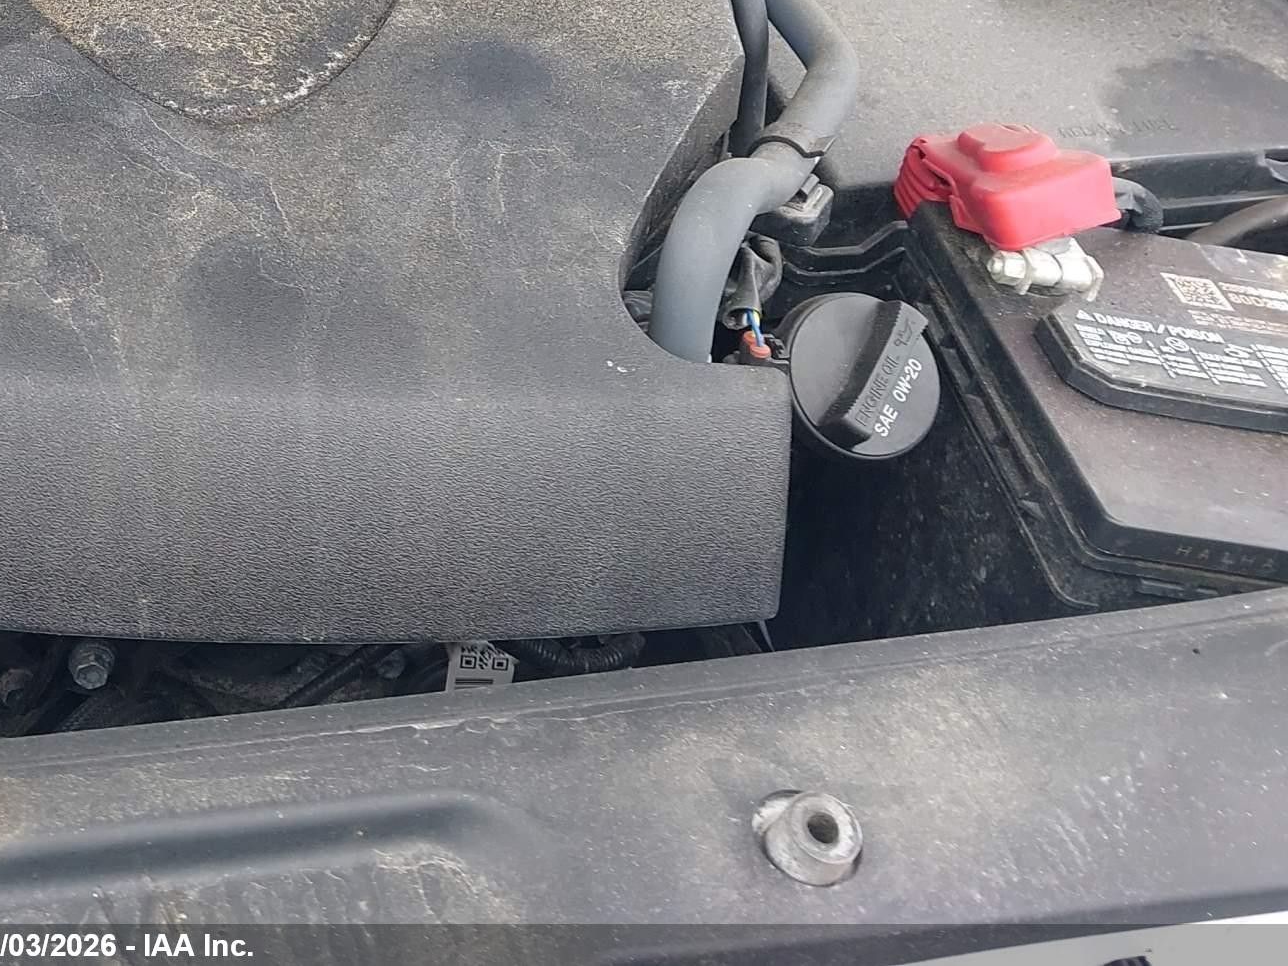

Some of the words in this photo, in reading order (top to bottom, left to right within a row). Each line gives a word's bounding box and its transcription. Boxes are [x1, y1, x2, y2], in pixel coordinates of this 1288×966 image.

[1093, 312, 1156, 333] DANGER
[1167, 326, 1225, 344] POISON
[874, 404, 899, 437] SAE
[892, 358, 923, 402] 0W-20
